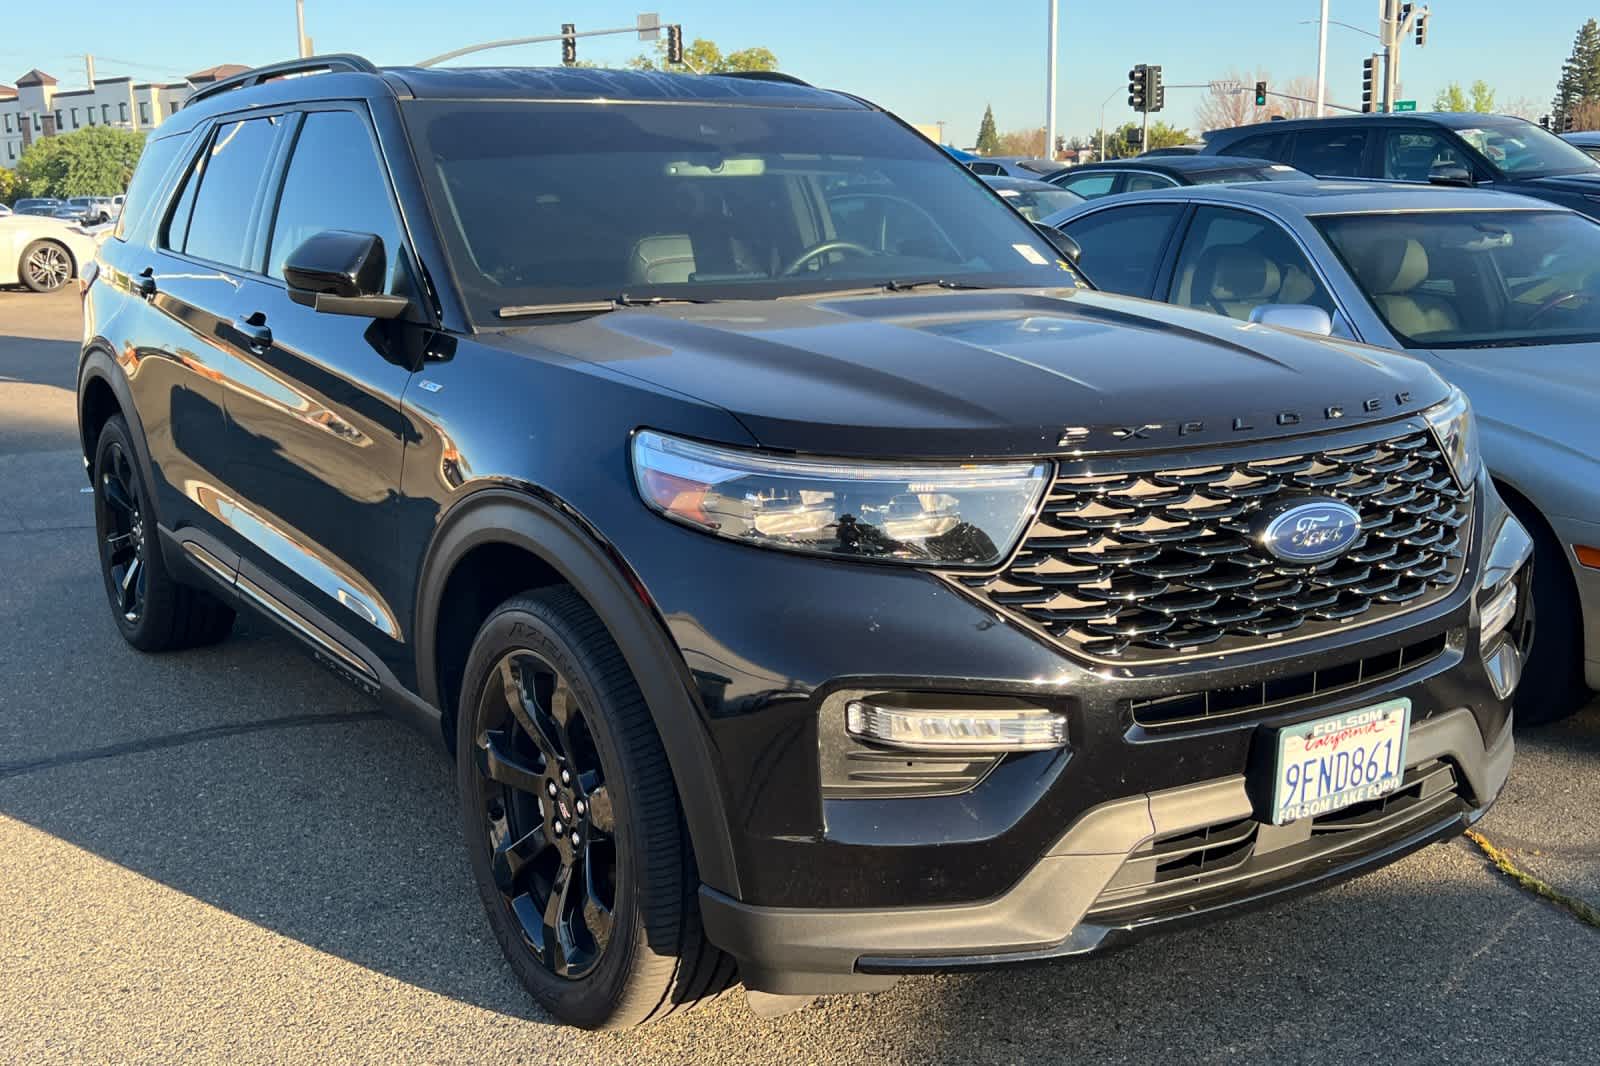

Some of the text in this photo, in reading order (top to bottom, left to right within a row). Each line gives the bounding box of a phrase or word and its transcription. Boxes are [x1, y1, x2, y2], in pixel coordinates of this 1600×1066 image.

[1056, 391, 1413, 447] EXPLORER
[1292, 515, 1344, 546] Ford
[1304, 720, 1385, 752] California
[1313, 709, 1383, 737] FOLSOM
[1284, 738, 1393, 808] 9FND861
[1279, 776, 1401, 821] FOLSOM LAKE FORD
